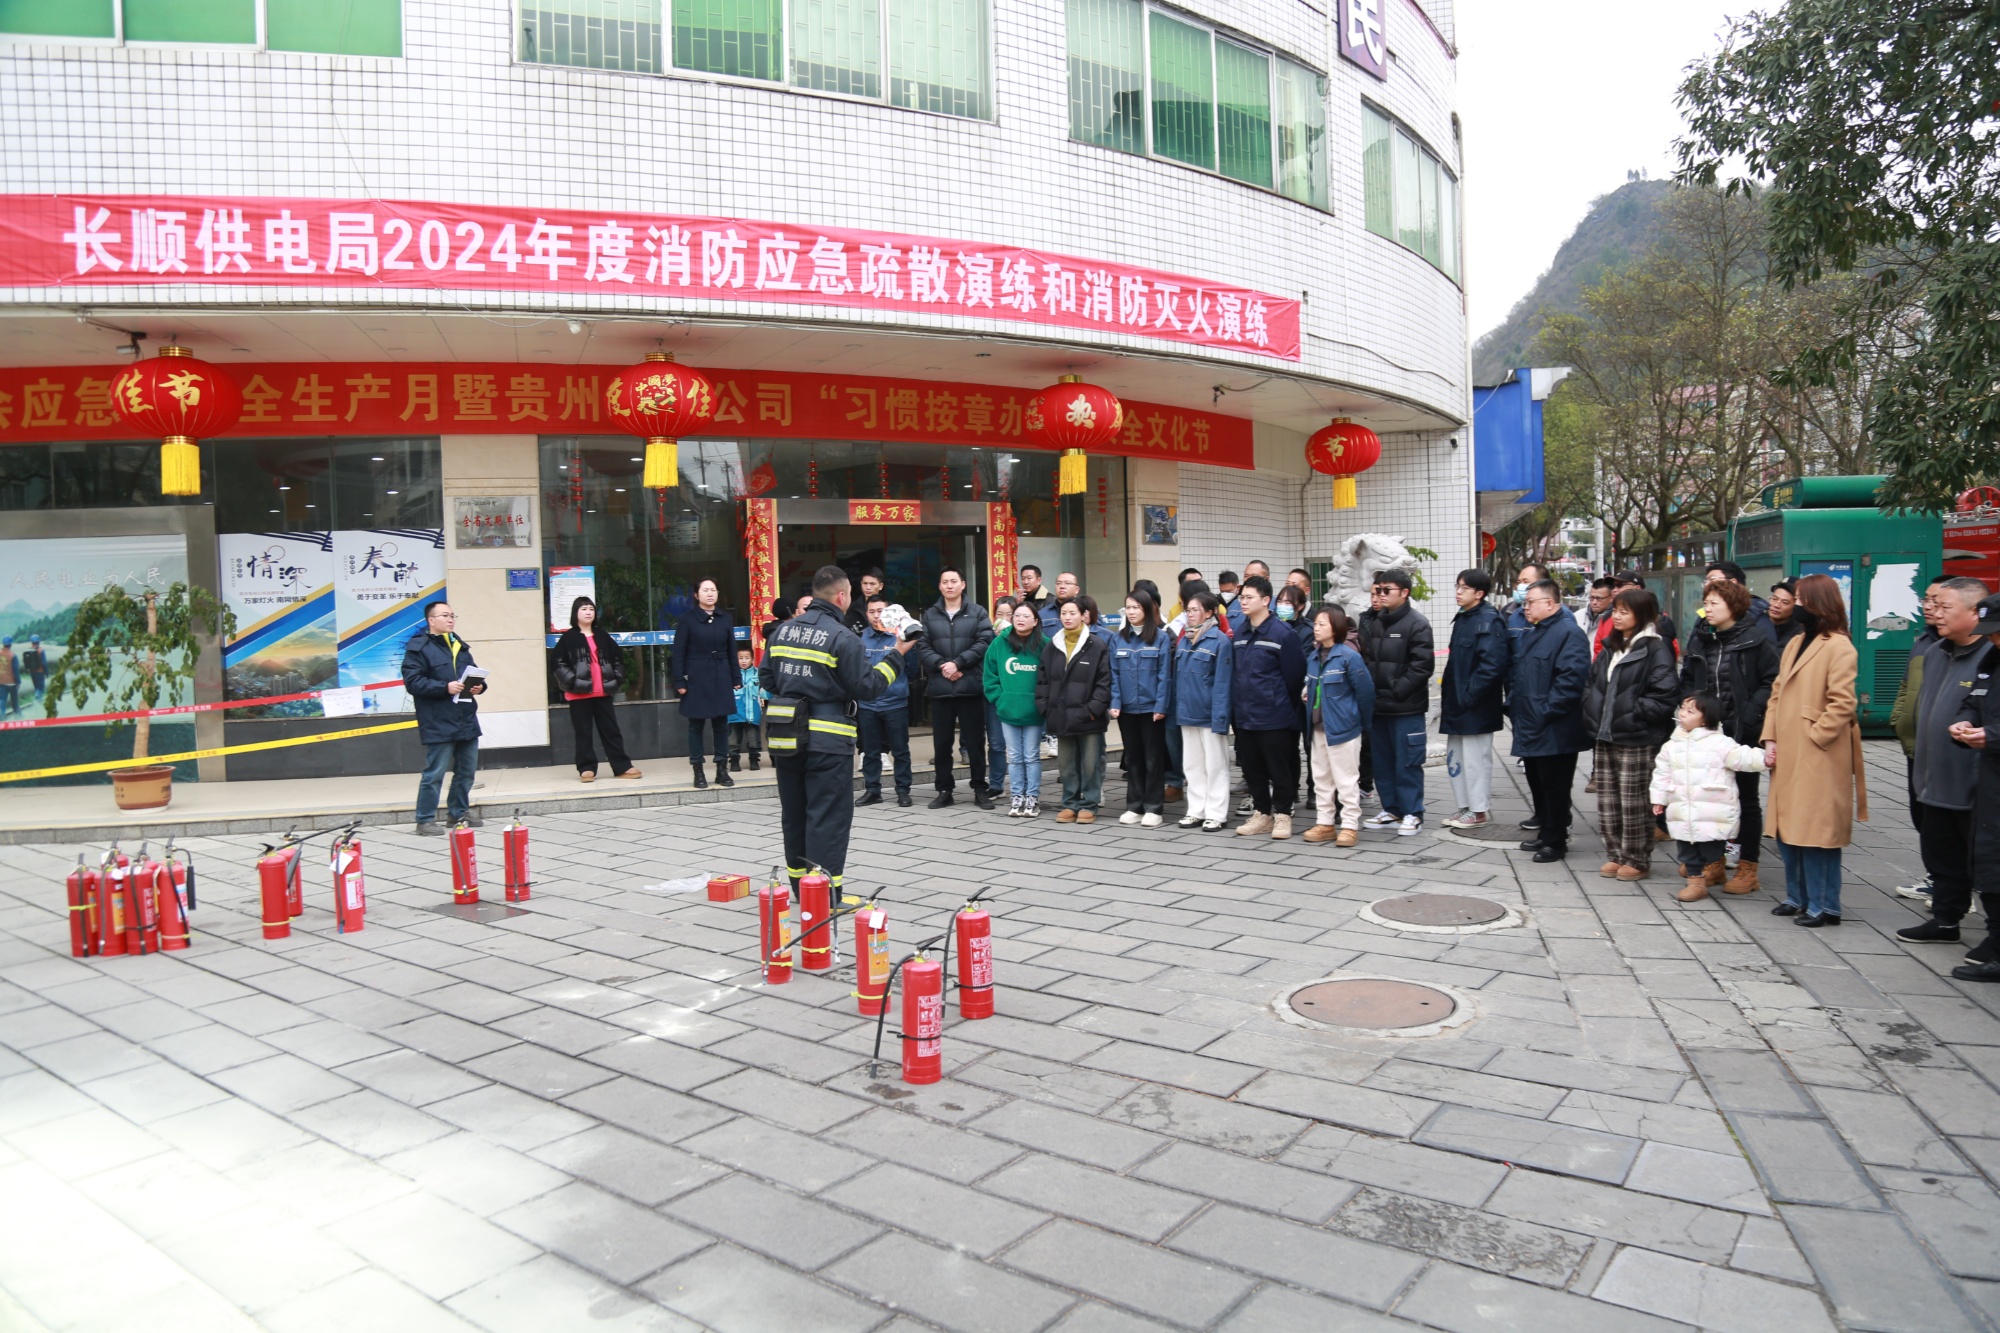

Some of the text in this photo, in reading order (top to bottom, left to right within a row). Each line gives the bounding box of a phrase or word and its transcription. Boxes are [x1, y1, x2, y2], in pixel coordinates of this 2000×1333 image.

[64, 206, 1269, 347] 长顺供电局2024年度消防应急疏散演练和消防灭火演练
[114, 368, 205, 417] 佳节
[463, 514, 525, 527] 全省文明单位
[855, 505, 915, 522] 服务万家
[11, 567, 165, 589] 人民电业为人民
[246, 551, 313, 594] 情深
[358, 545, 424, 588] 奉献
[993, 518, 1007, 600] 南网情深点
[777, 625, 829, 647] 贵州消防
